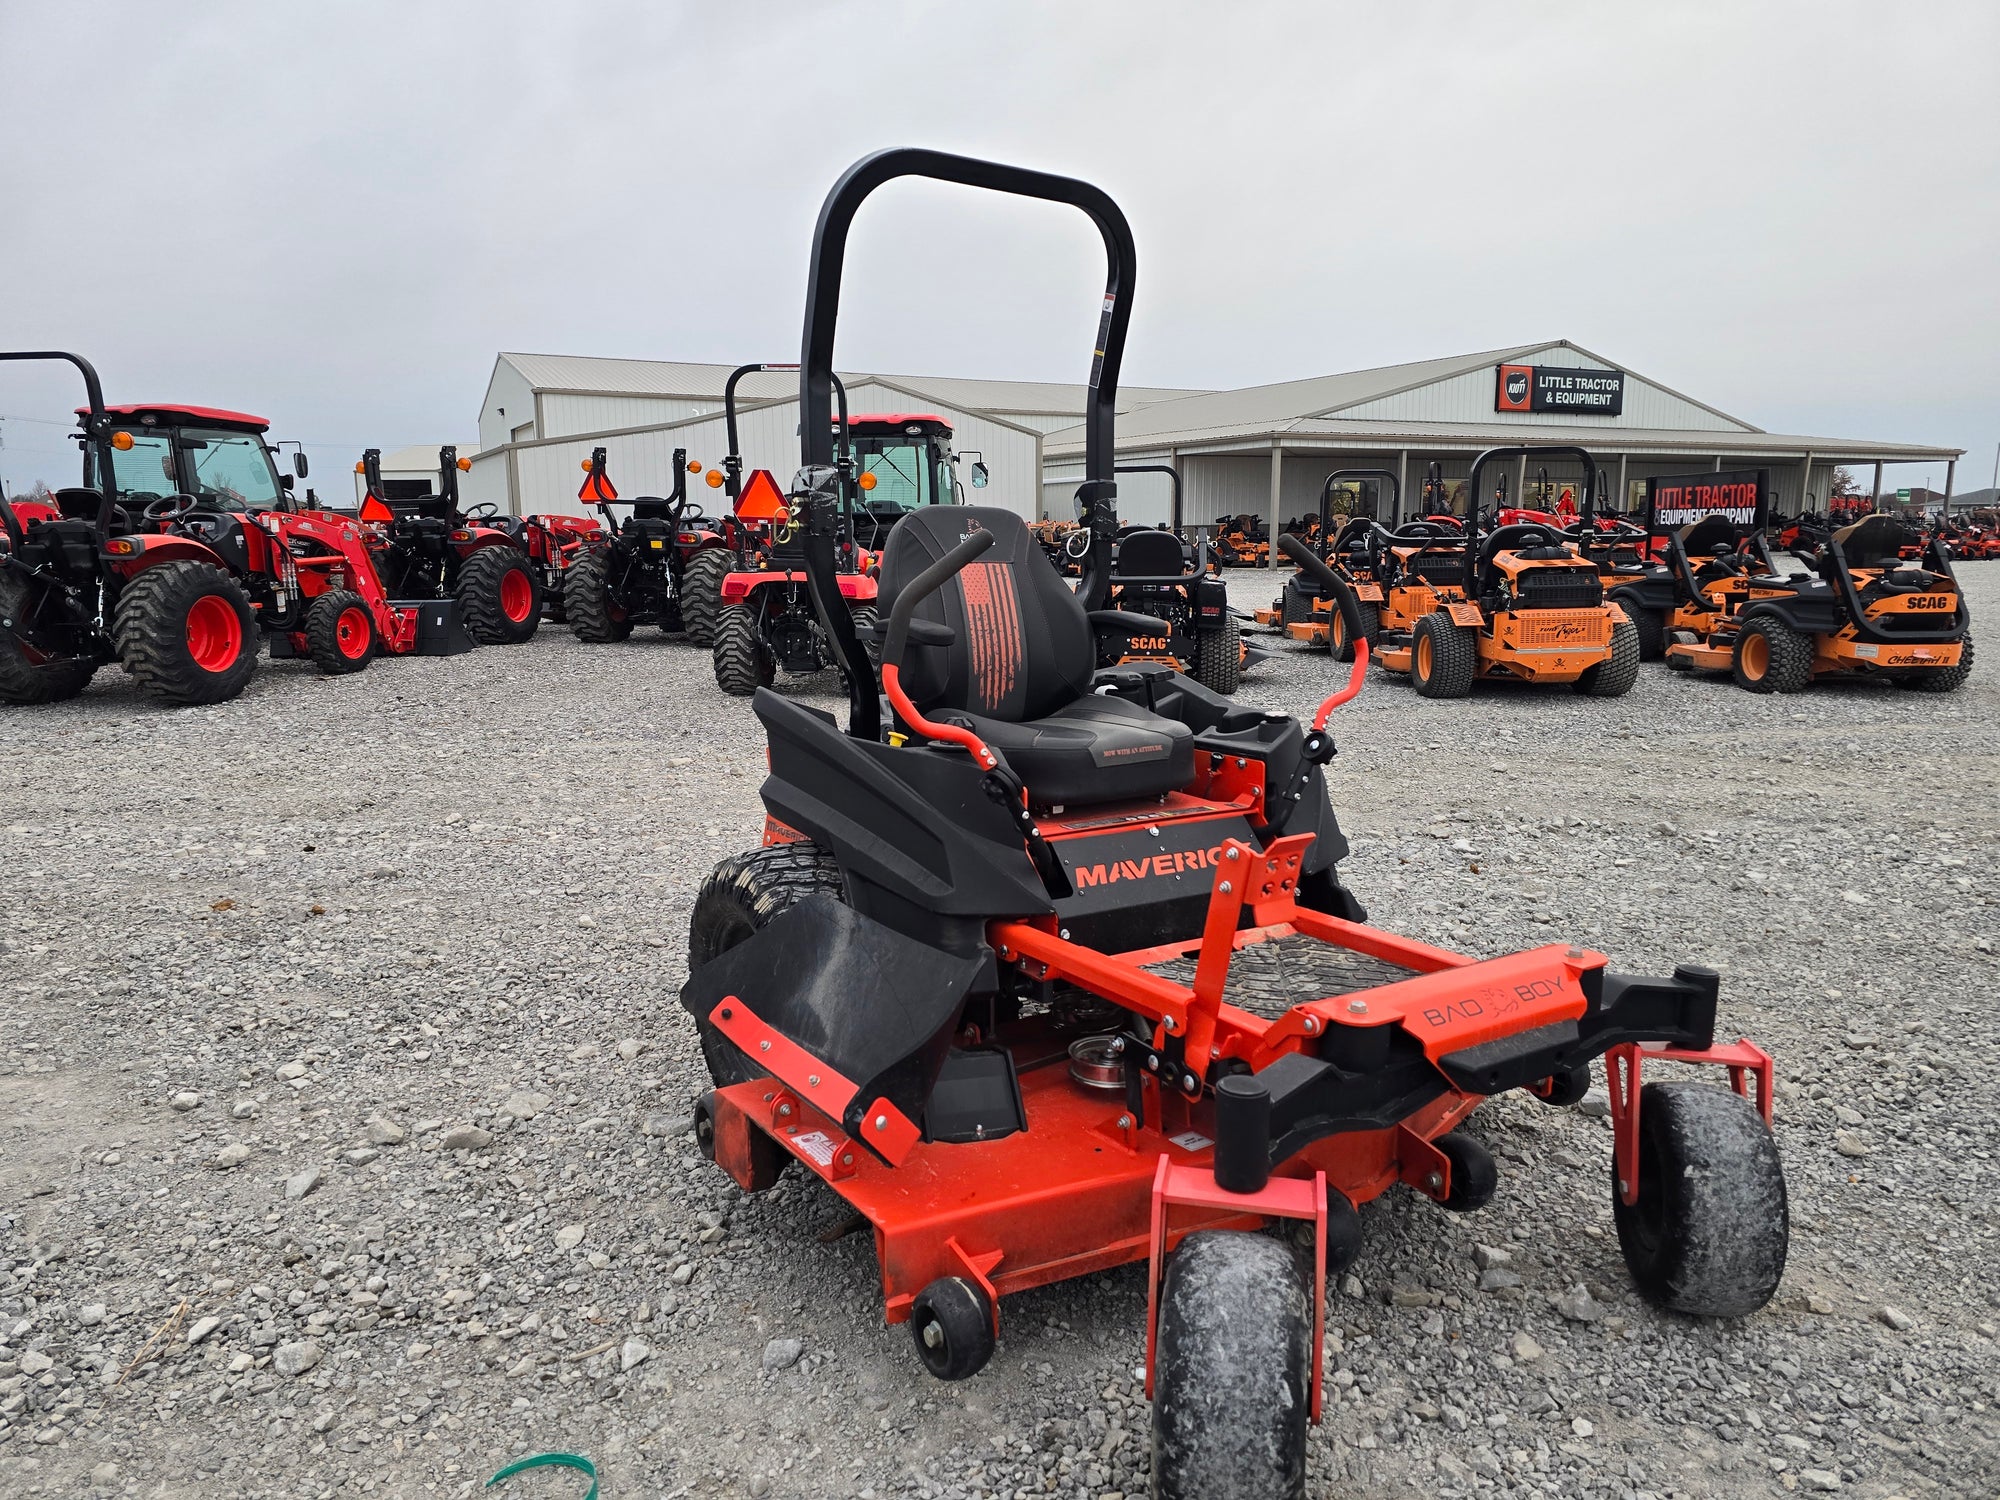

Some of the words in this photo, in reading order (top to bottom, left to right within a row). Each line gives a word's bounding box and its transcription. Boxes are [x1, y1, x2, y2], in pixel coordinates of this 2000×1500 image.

[1539, 375, 1573, 389] LITTLE
[1575, 377, 1620, 391] TRACTOR
[1545, 391, 1553, 403] &
[1555, 391, 1612, 405] EQUIPMENT
[1655, 486, 1693, 509] LITTLE
[1695, 483, 1757, 508] TRACTOR
[1906, 596, 1947, 609] SCAG
[1130, 637, 1167, 650] SCAG
[1075, 846, 1222, 888] MAVERIC
[1423, 999, 1484, 1027] BAD
[1514, 976, 1565, 1002] BOY
